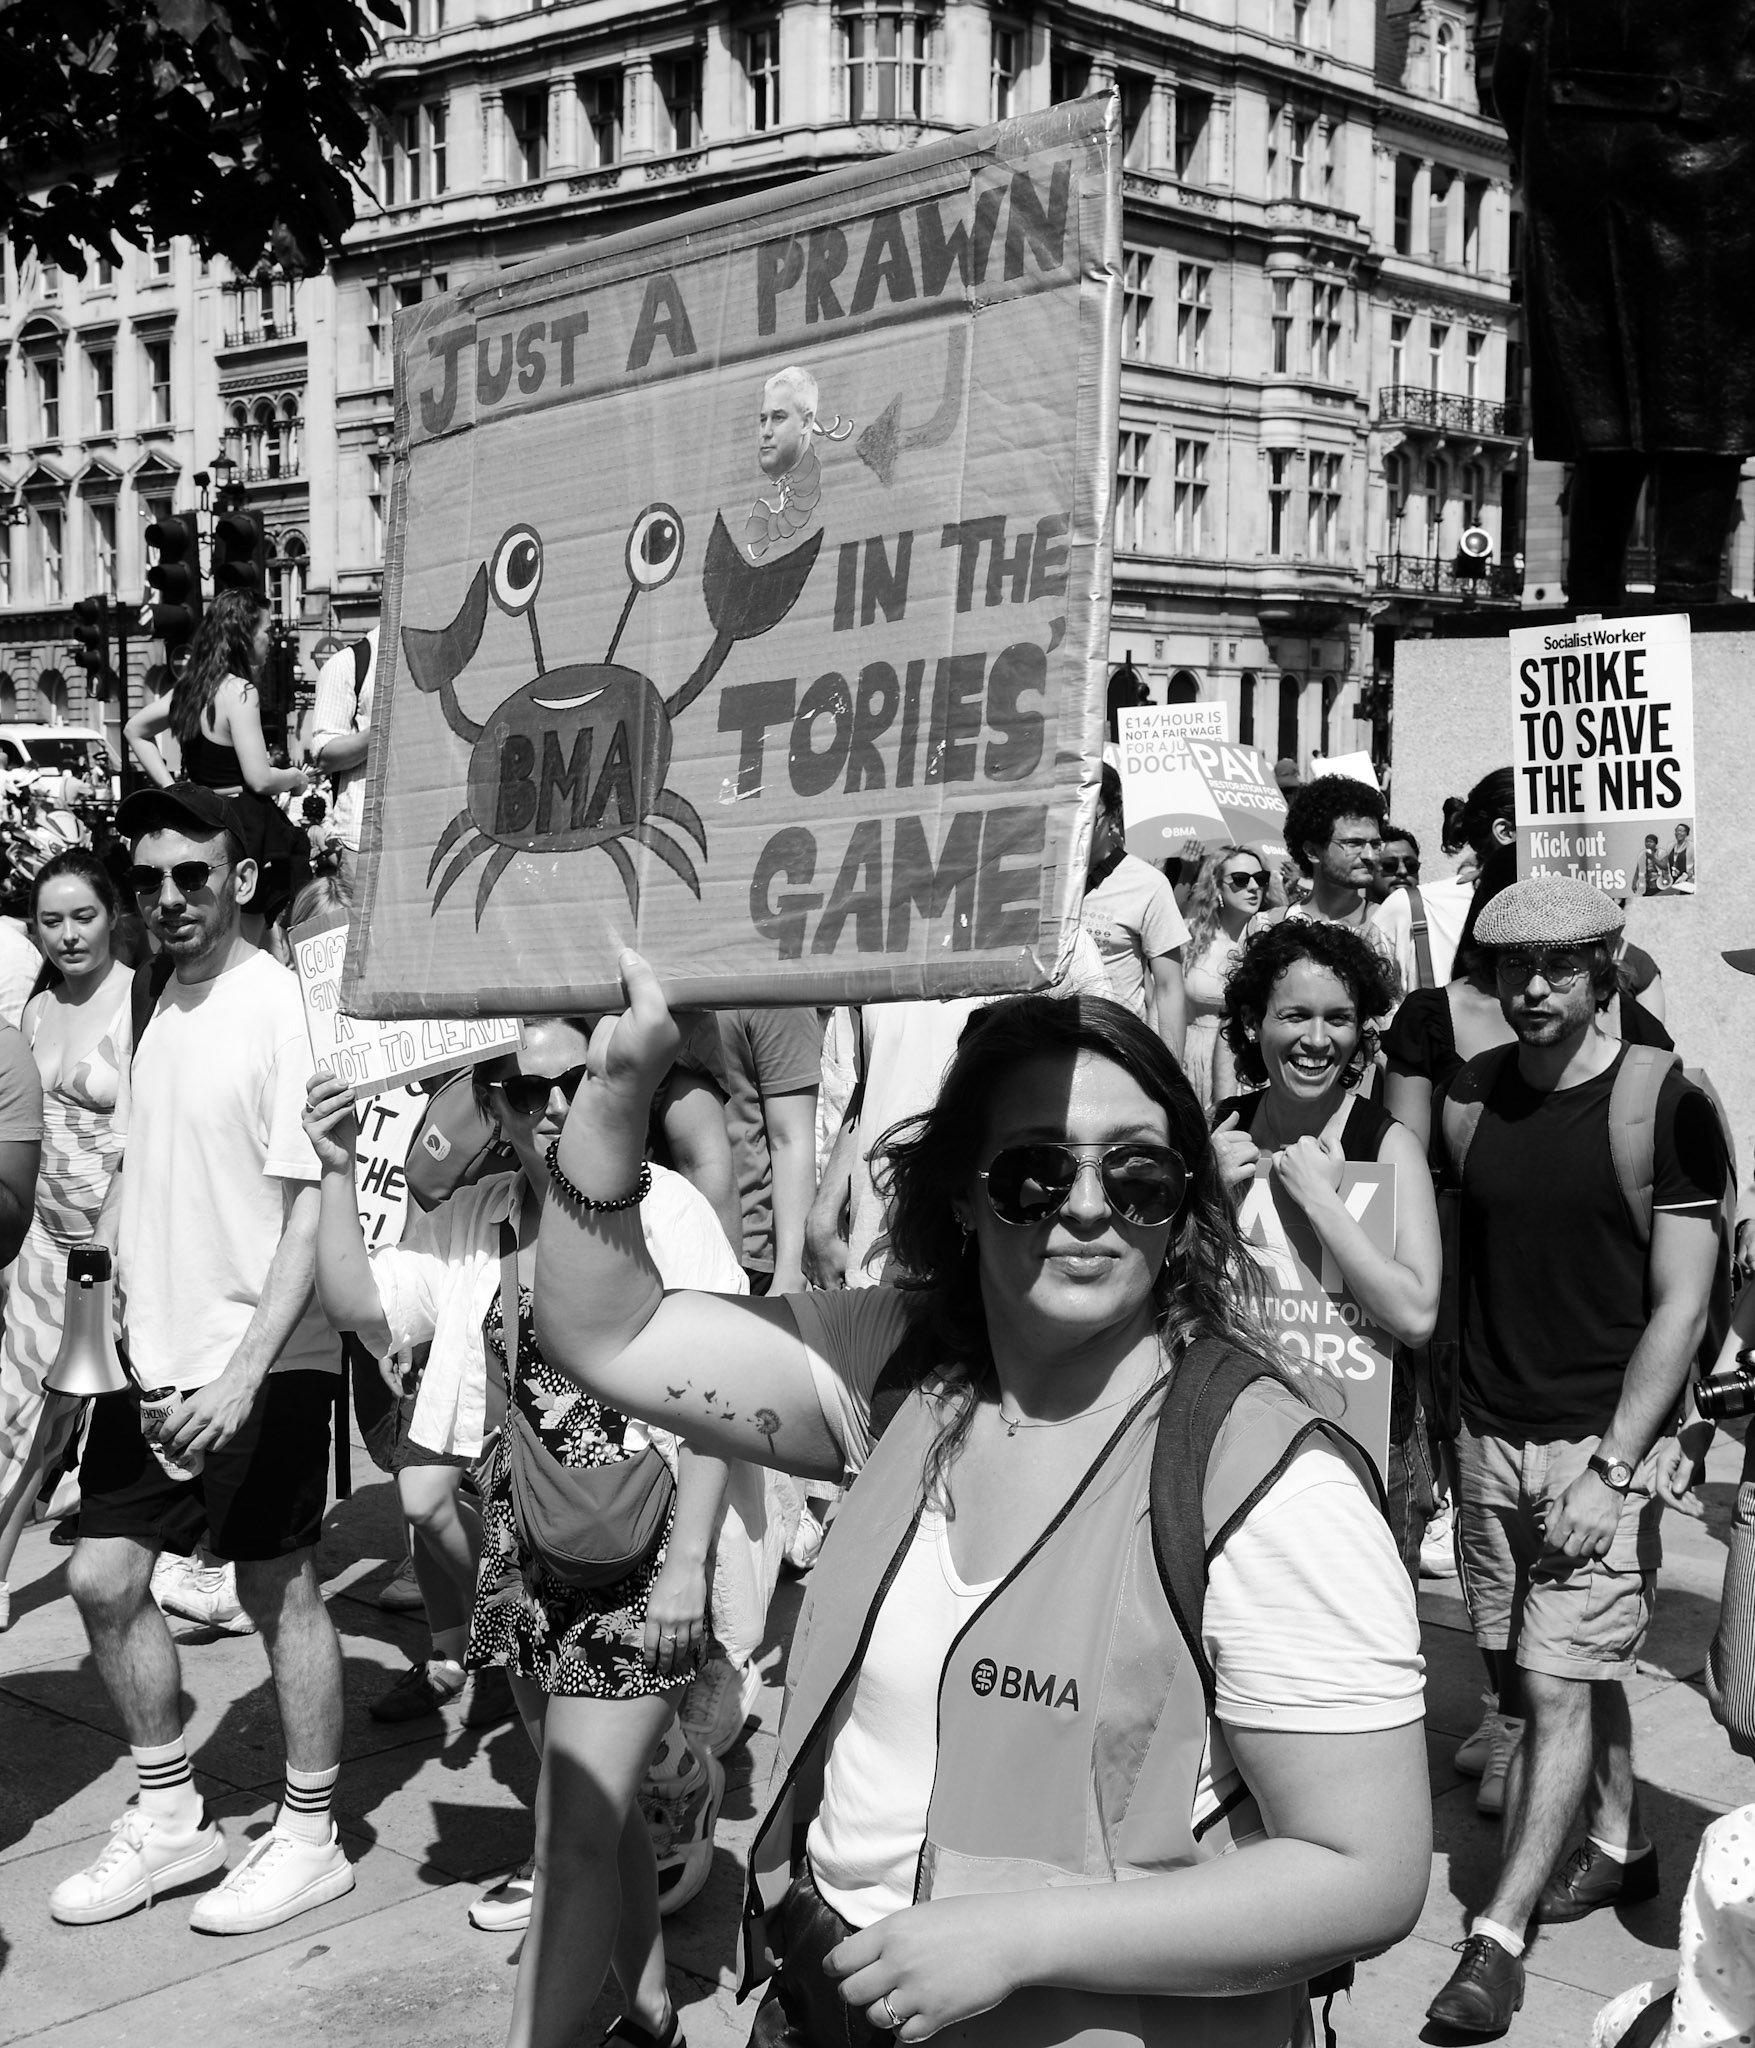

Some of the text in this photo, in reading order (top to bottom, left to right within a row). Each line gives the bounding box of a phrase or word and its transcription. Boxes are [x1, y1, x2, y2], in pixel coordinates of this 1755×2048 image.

[420, 160, 1072, 435] JUST A PRAWN
[832, 511, 1070, 632] IN THE
[1520, 649, 1648, 708] STRIKE
[717, 616, 1066, 800] TORIES'
[1125, 711, 1222, 729] £14/HOUR IS
[1125, 725, 1222, 741] NOT A FAIR WAGE
[1126, 742, 1154, 754] FOR
[1158, 741, 1168, 752] A
[1520, 703, 1673, 761] TO SAVE
[494, 719, 634, 835] BMA
[1127, 754, 1198, 775] DOCT
[1189, 742, 1265, 785] PAY
[1207, 779, 1280, 797] RESTORATION FOR
[1212, 789, 1287, 812] DOCTORS
[1521, 757, 1682, 815] THE NHS
[1172, 826, 1197, 837] BMA
[1530, 830, 1607, 858] Kick out
[749, 805, 1049, 960] GAME
[379, 1031, 416, 1073] TO
[1000, 1665, 1079, 1712] BMA
